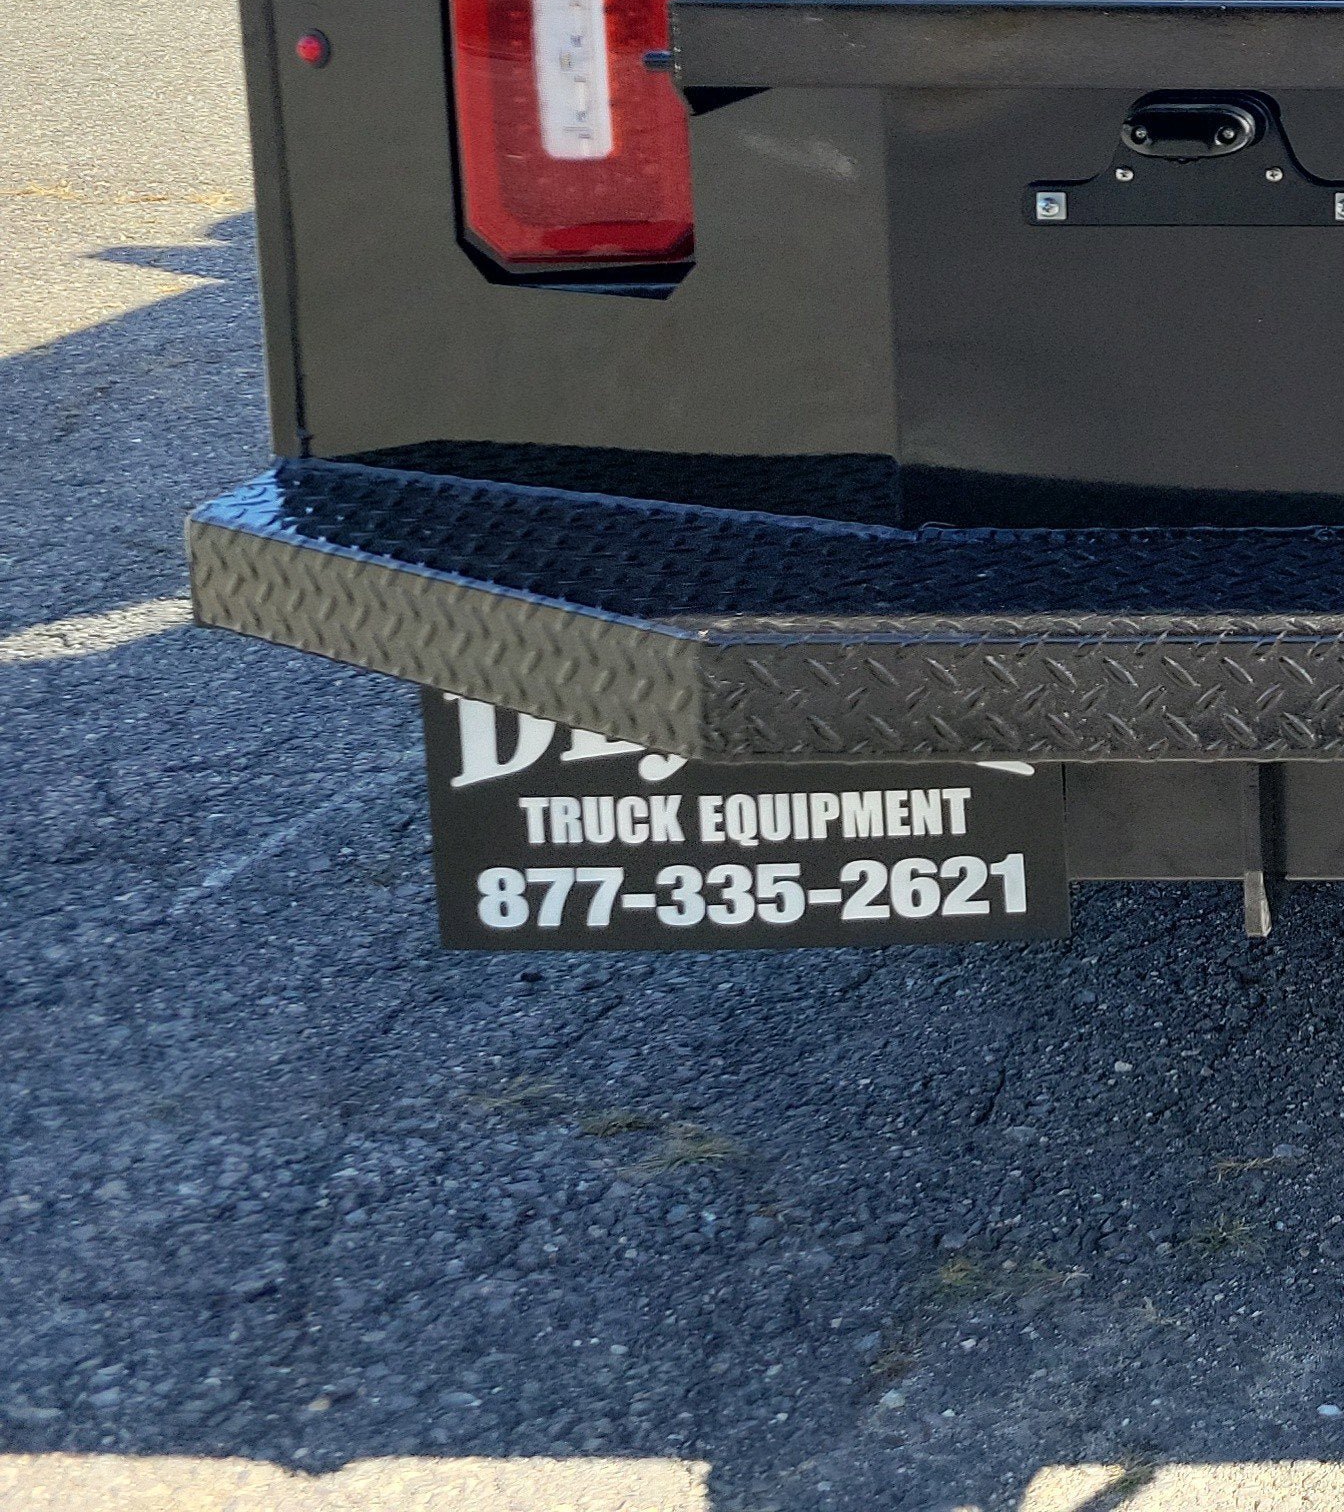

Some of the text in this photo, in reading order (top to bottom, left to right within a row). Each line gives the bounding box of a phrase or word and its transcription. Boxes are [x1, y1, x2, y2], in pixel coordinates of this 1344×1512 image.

[518, 788, 972, 846] TRUCK EQUIPMENT
[476, 852, 1028, 929] 877-335-2621
